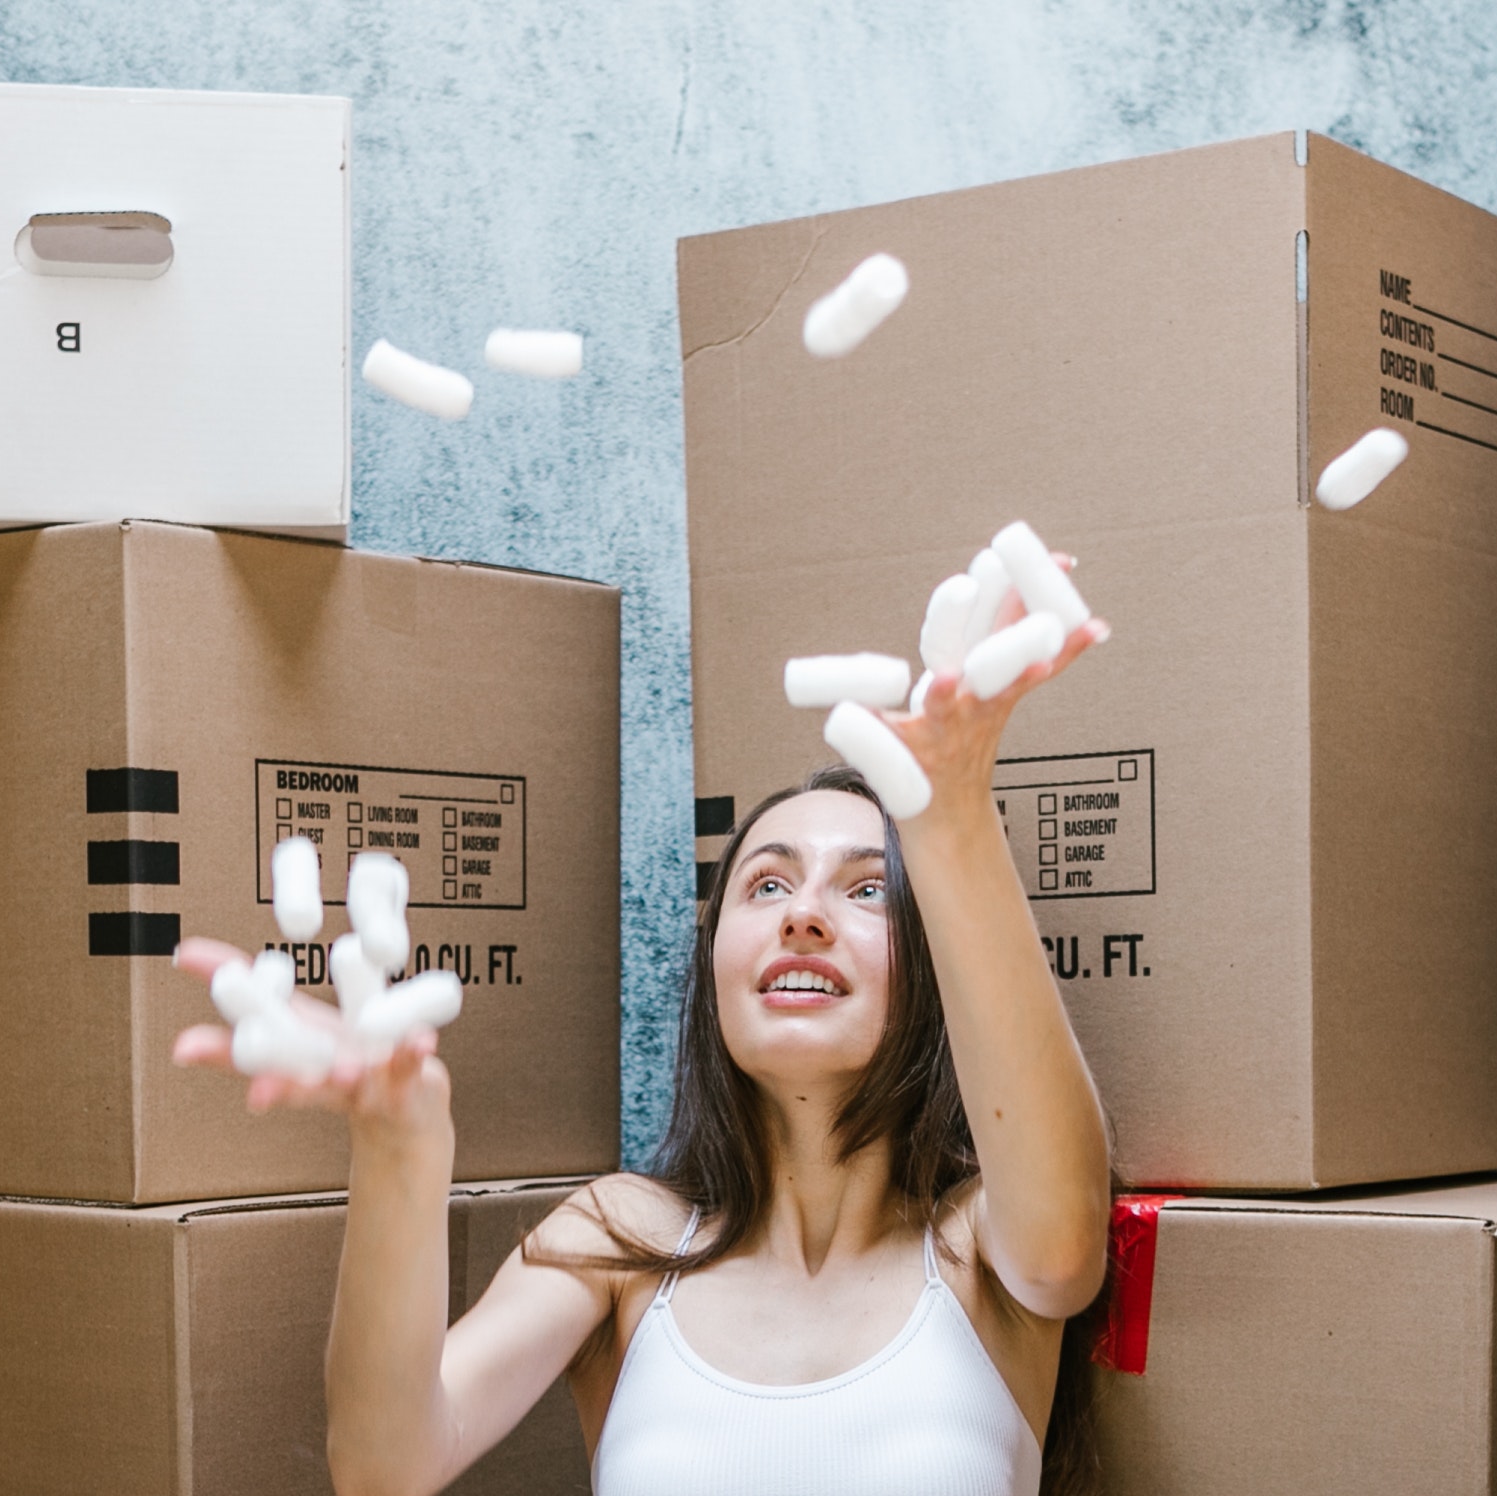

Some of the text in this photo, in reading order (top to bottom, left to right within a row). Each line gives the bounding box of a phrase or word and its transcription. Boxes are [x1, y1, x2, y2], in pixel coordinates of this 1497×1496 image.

[1380, 269, 1411, 305] NAME
[56, 322, 80, 353] B
[1380, 308, 1435, 353] CONTENTS
[1380, 348, 1438, 393] ORDER NO.
[1380, 386, 1414, 423] ROOM
[276, 770, 359, 794] BEDROOM
[297, 802, 331, 820] MASTER
[1064, 793, 1120, 812] BATHROOM
[367, 805, 418, 825] LIVING ROOM
[461, 811, 502, 829] BATHROOM
[1064, 818, 1117, 837] BASEMENT
[367, 830, 420, 849] DINING ROOM
[461, 835, 500, 852] BASEMENT
[1065, 844, 1105, 863] GARAGE
[461, 859, 492, 876] GARAGE
[1065, 870, 1093, 888] ATTIC
[461, 883, 482, 899] ATTIC
[489, 945, 522, 985] FT.
[1104, 934, 1151, 978] FT.
